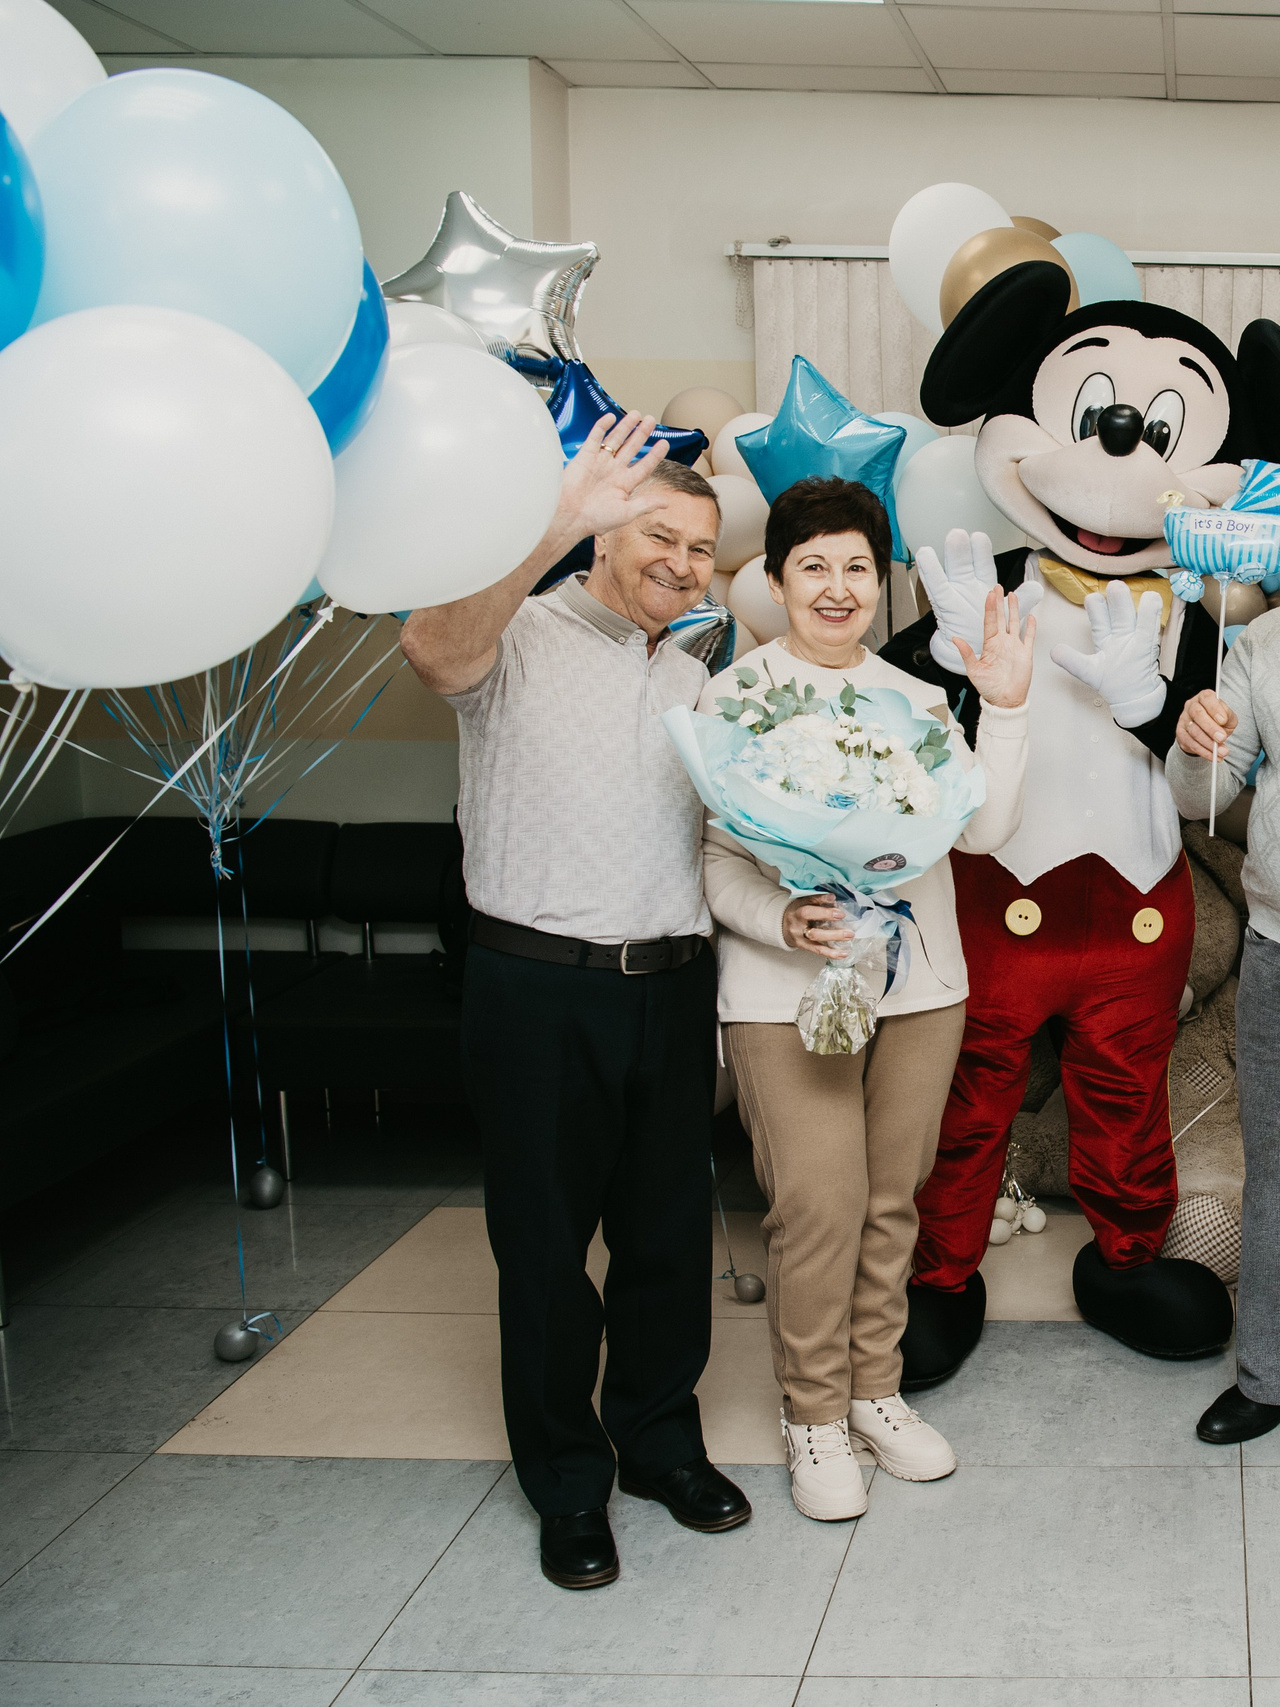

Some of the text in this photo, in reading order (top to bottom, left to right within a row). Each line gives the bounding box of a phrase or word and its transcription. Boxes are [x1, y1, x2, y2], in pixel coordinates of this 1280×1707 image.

[1194, 518, 1255, 533] it's a Boy!
